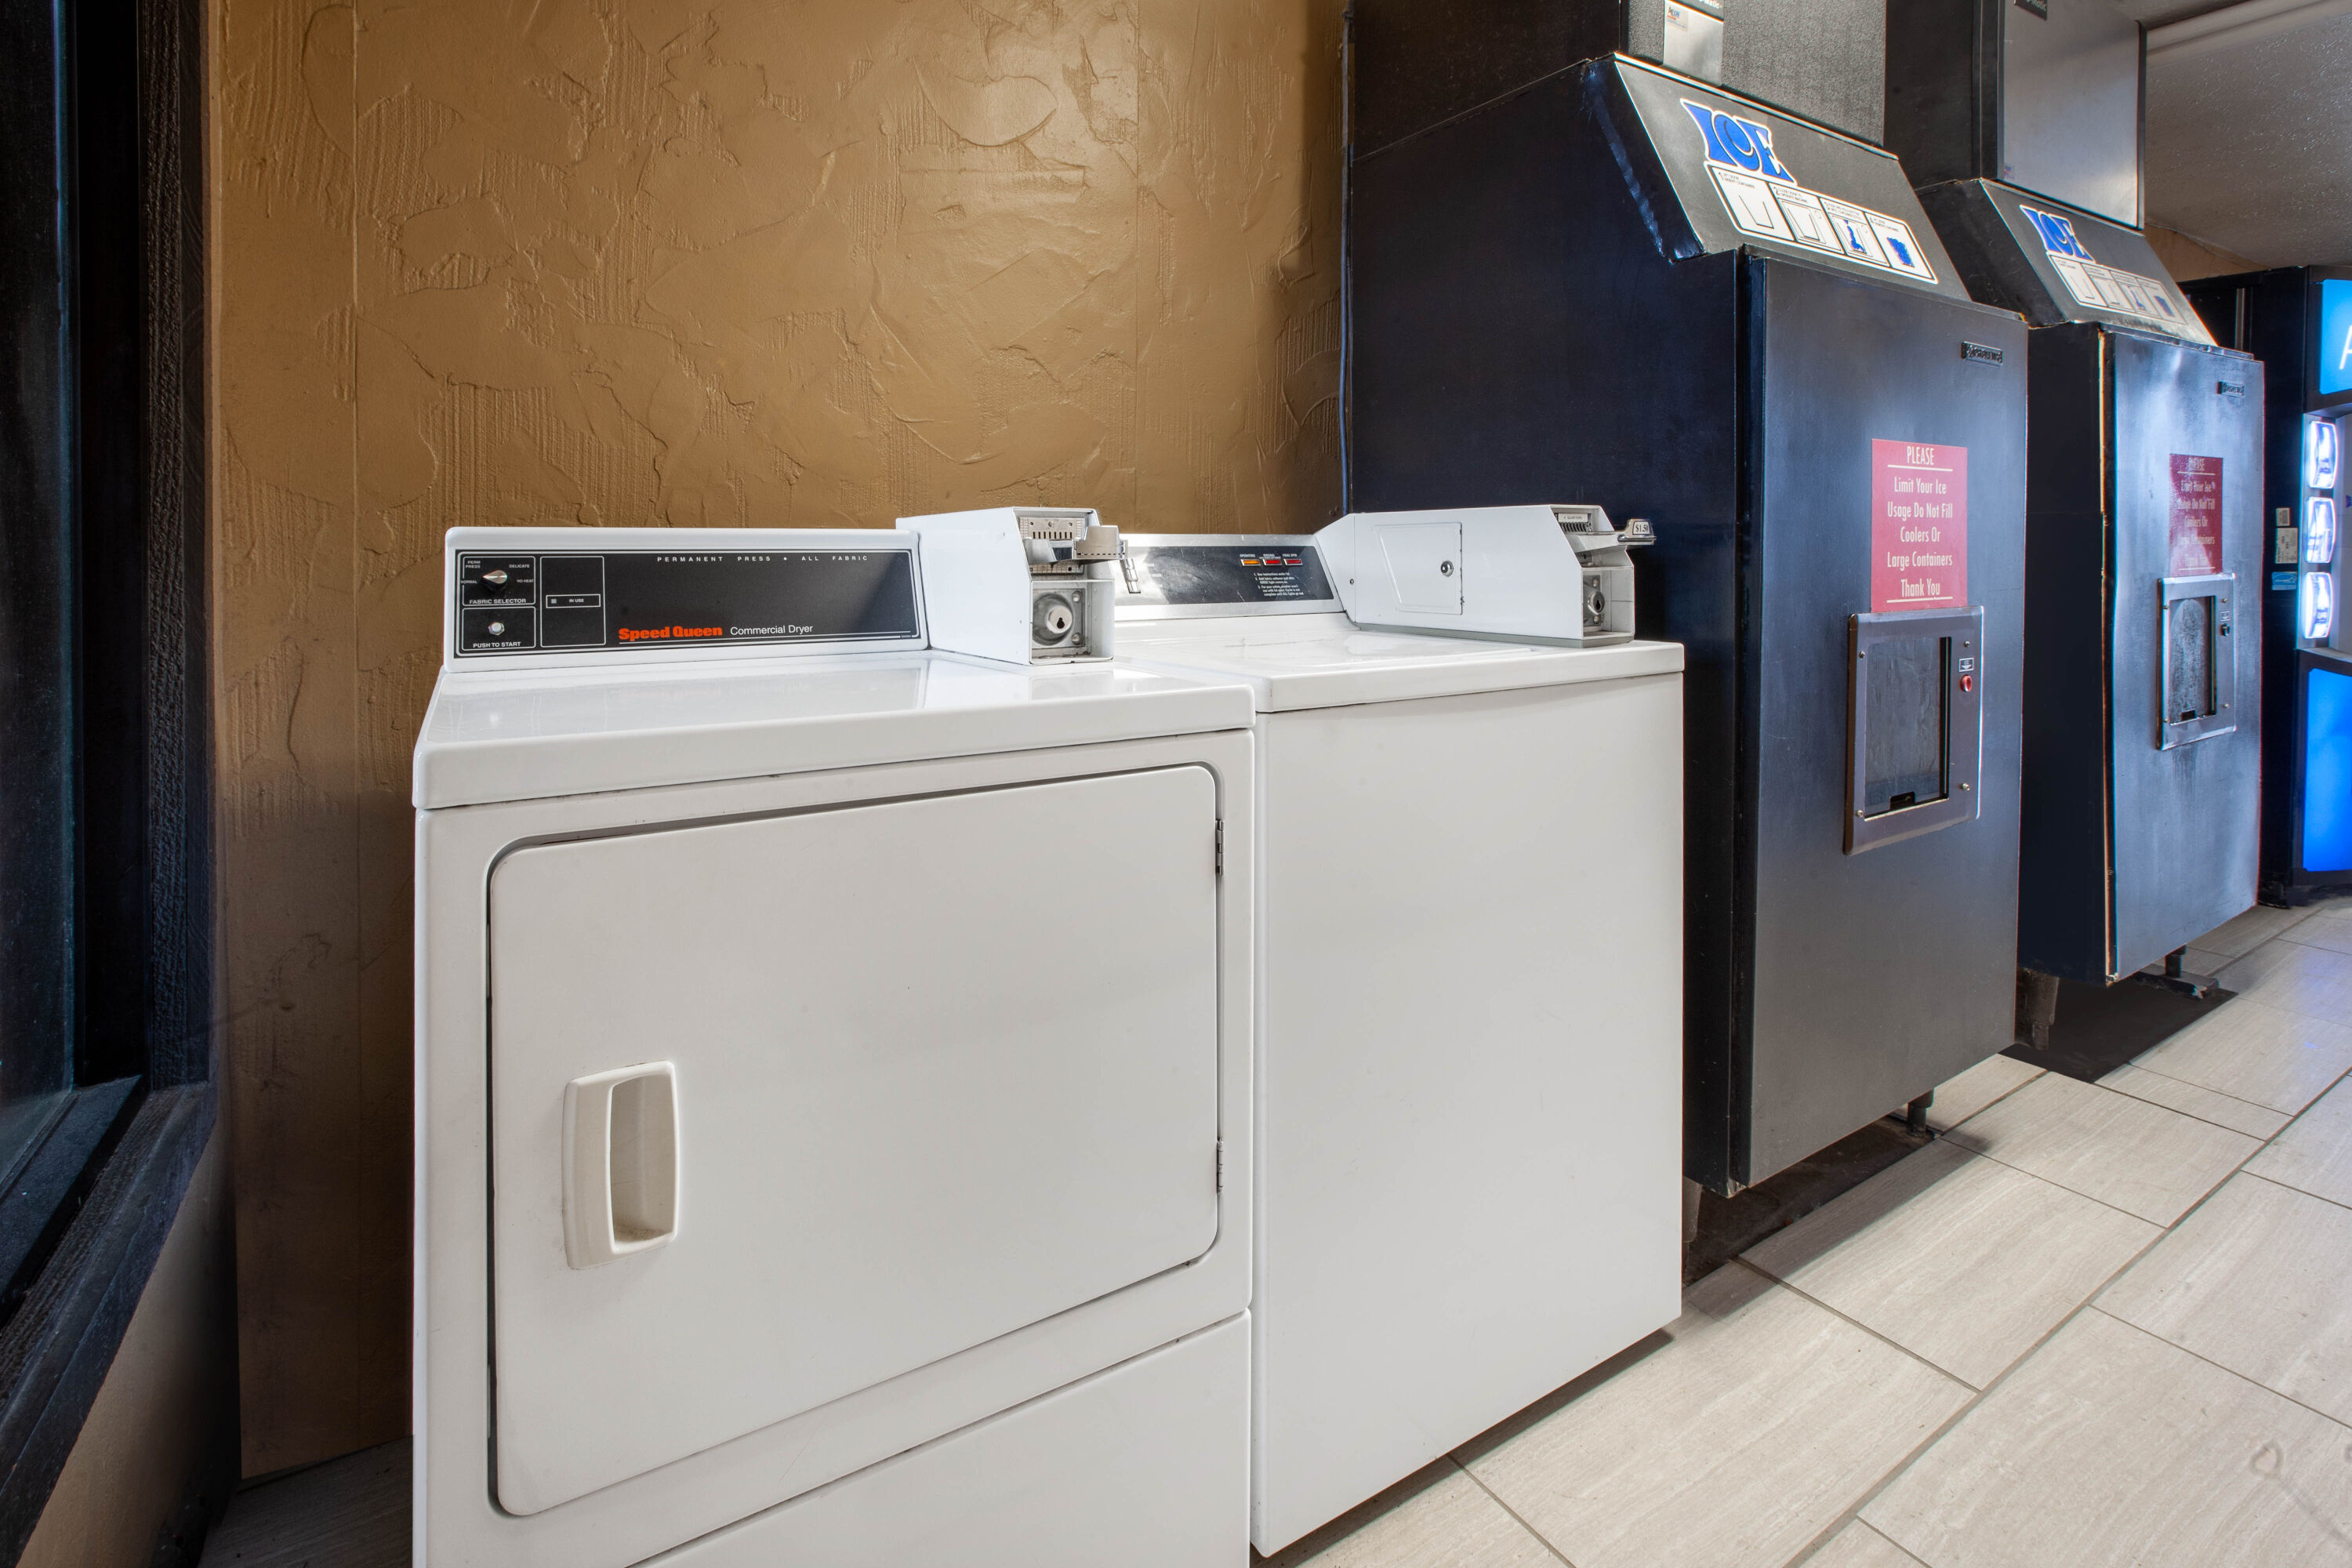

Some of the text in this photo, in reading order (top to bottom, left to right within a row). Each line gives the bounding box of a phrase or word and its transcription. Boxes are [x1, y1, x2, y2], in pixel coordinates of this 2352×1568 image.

[1682, 100, 1795, 184] ICE
[2021, 206, 2096, 262] ICE
[1907, 446, 1934, 465] PLEASE
[1894, 477, 1947, 494] Limit Your Ice
[1887, 501, 1952, 521] Usage Do Not Fill
[1900, 526, 1940, 543] Coolers Or
[1887, 551, 1952, 571] Large Containers
[1900, 578, 1940, 597] Thank You
[619, 624, 813, 641] Speed Queen Commercial Dryer
